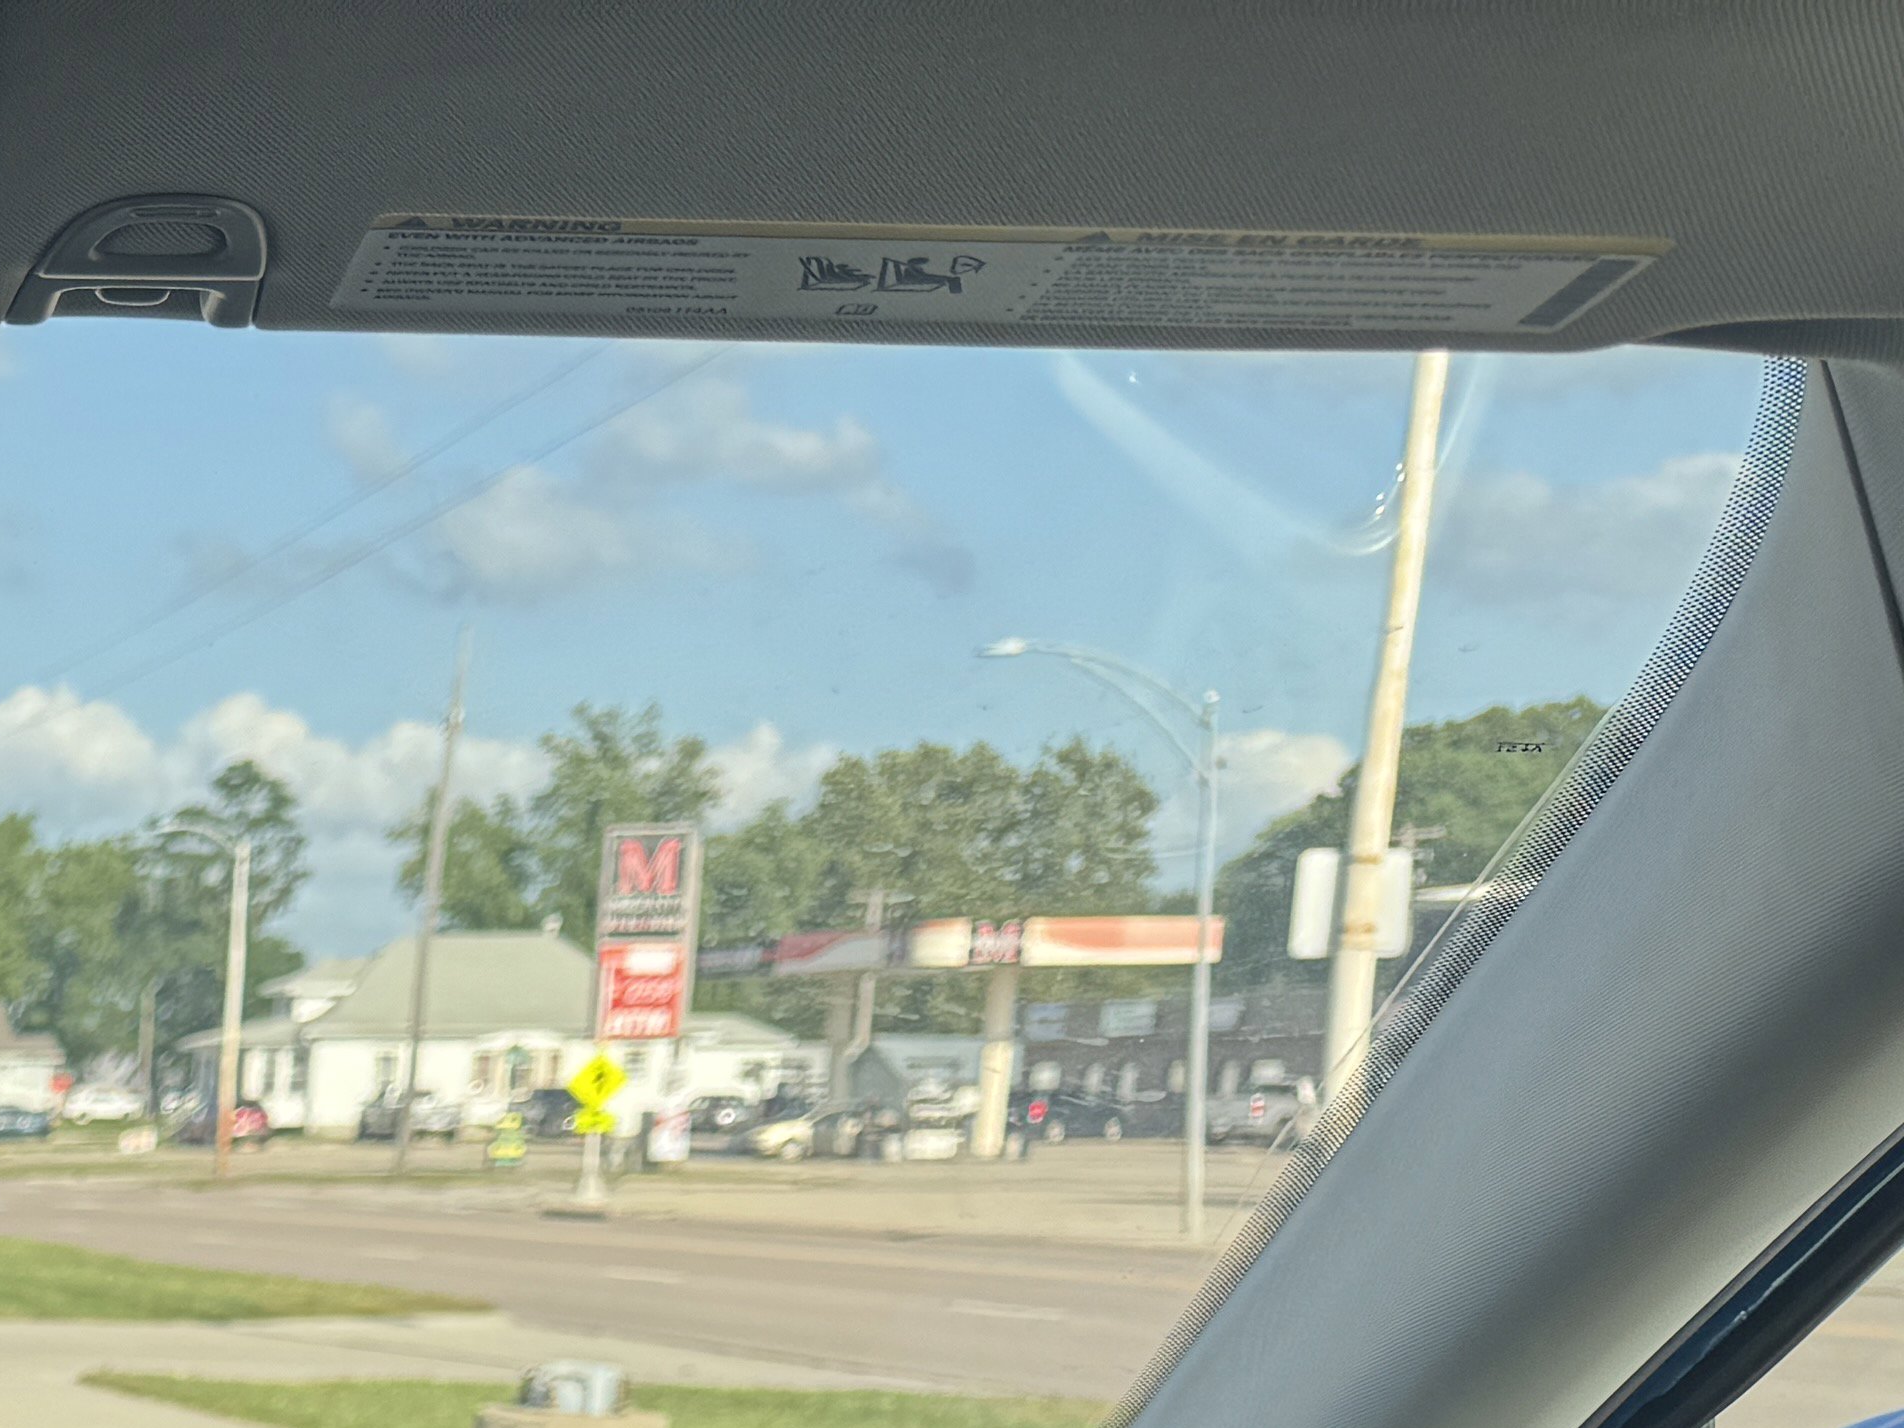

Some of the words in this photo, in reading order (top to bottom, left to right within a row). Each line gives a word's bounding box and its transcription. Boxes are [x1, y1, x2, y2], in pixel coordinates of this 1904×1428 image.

[450, 218, 622, 232] WARNING
[1136, 232, 1228, 244] MISE
[1234, 234, 1289, 245] EN
[618, 837, 681, 896] M
